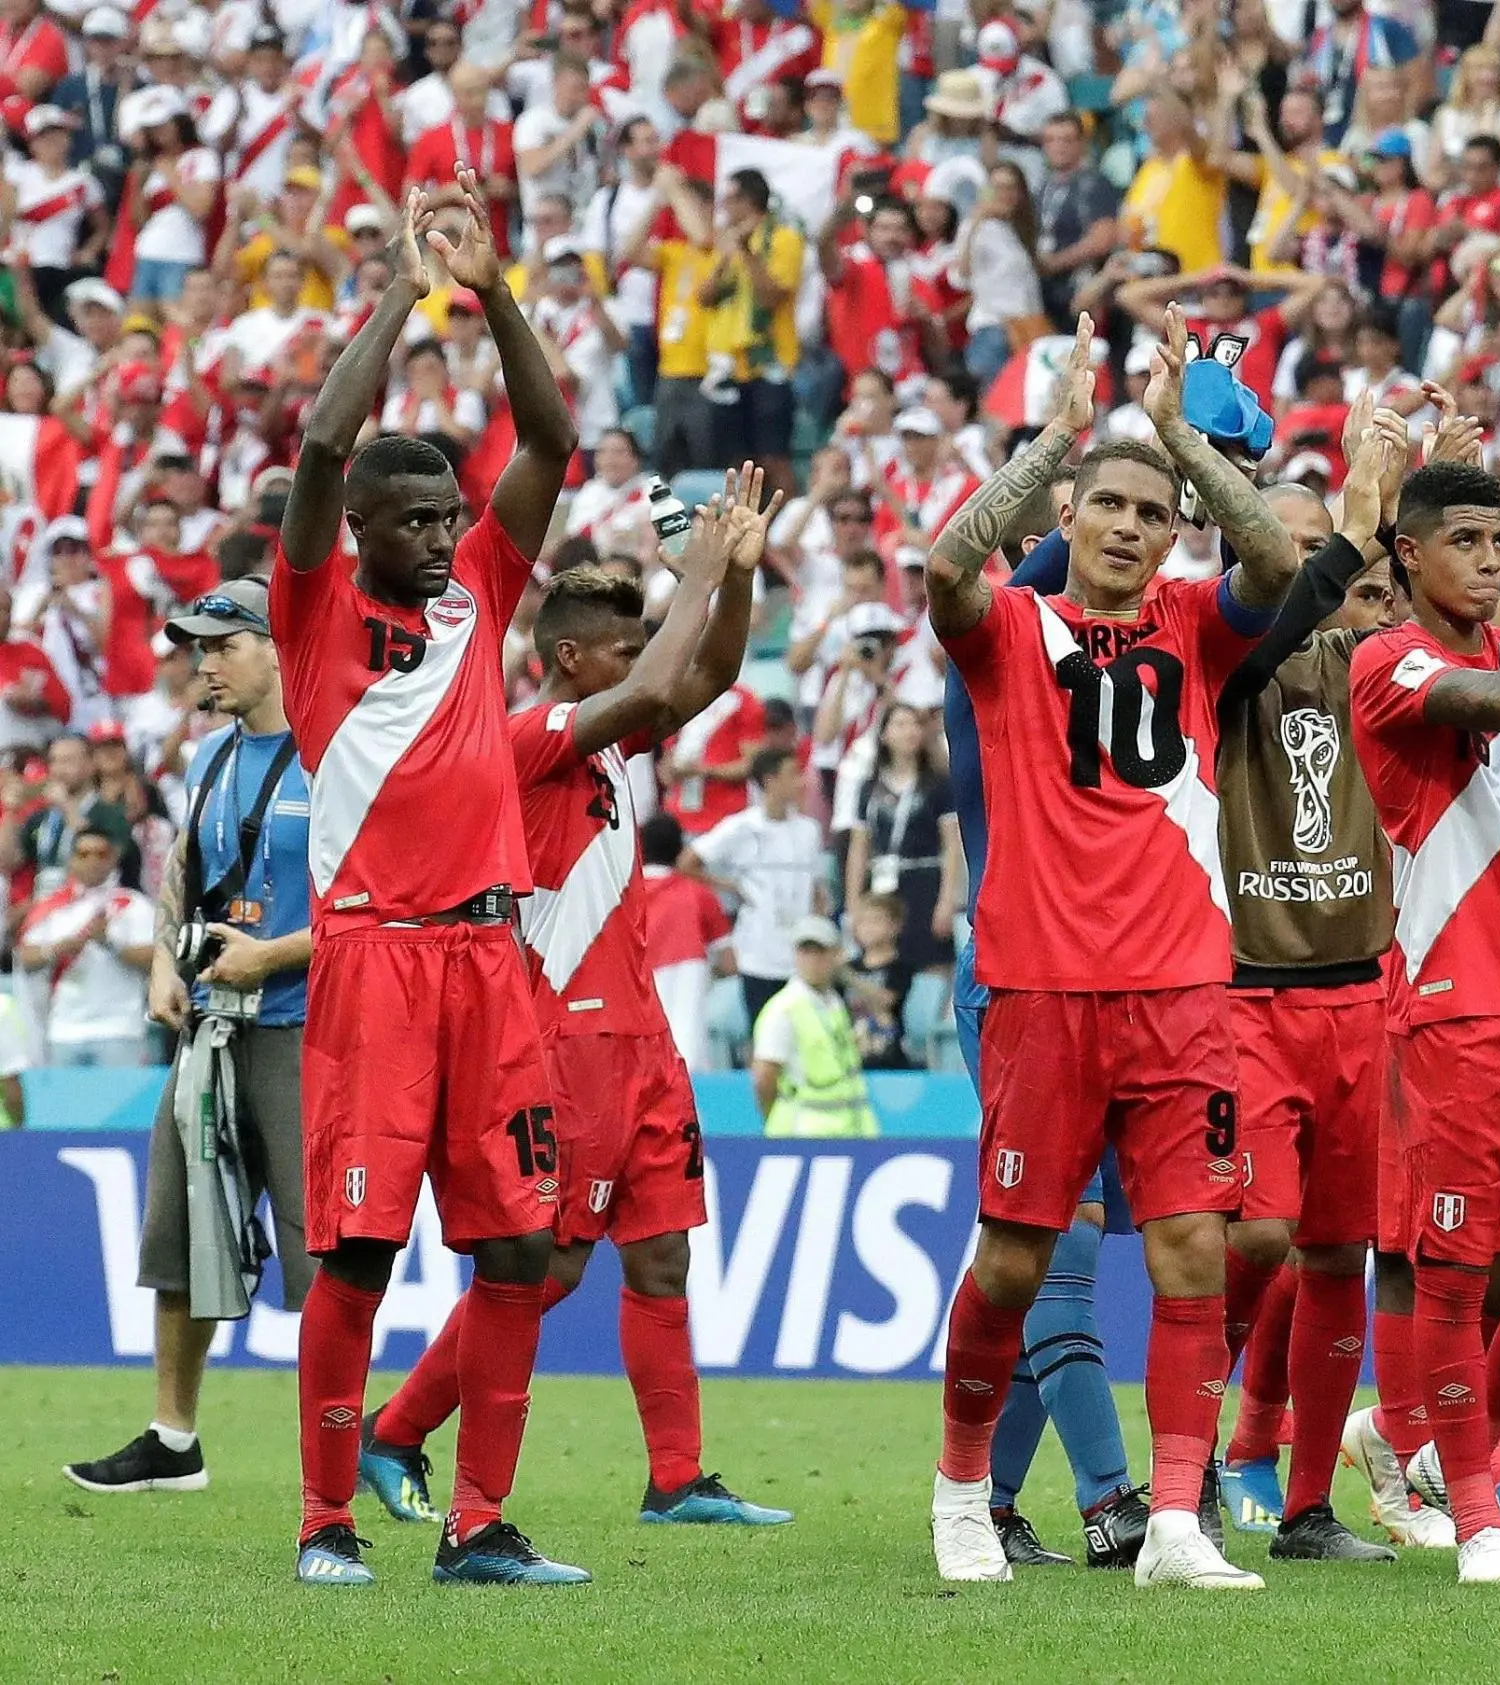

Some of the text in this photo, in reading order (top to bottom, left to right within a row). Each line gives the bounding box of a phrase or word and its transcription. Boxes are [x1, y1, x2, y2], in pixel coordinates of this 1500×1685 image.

[364, 616, 427, 673] 15
[1056, 648, 1186, 788] 10
[1238, 870, 1373, 902] RUSSIA 201
[1270, 856, 1359, 875] FIFA WORLD CUP
[506, 1104, 557, 1178] 15
[1205, 1090, 1237, 1158] 9
[692, 1154, 982, 1372] VIS
